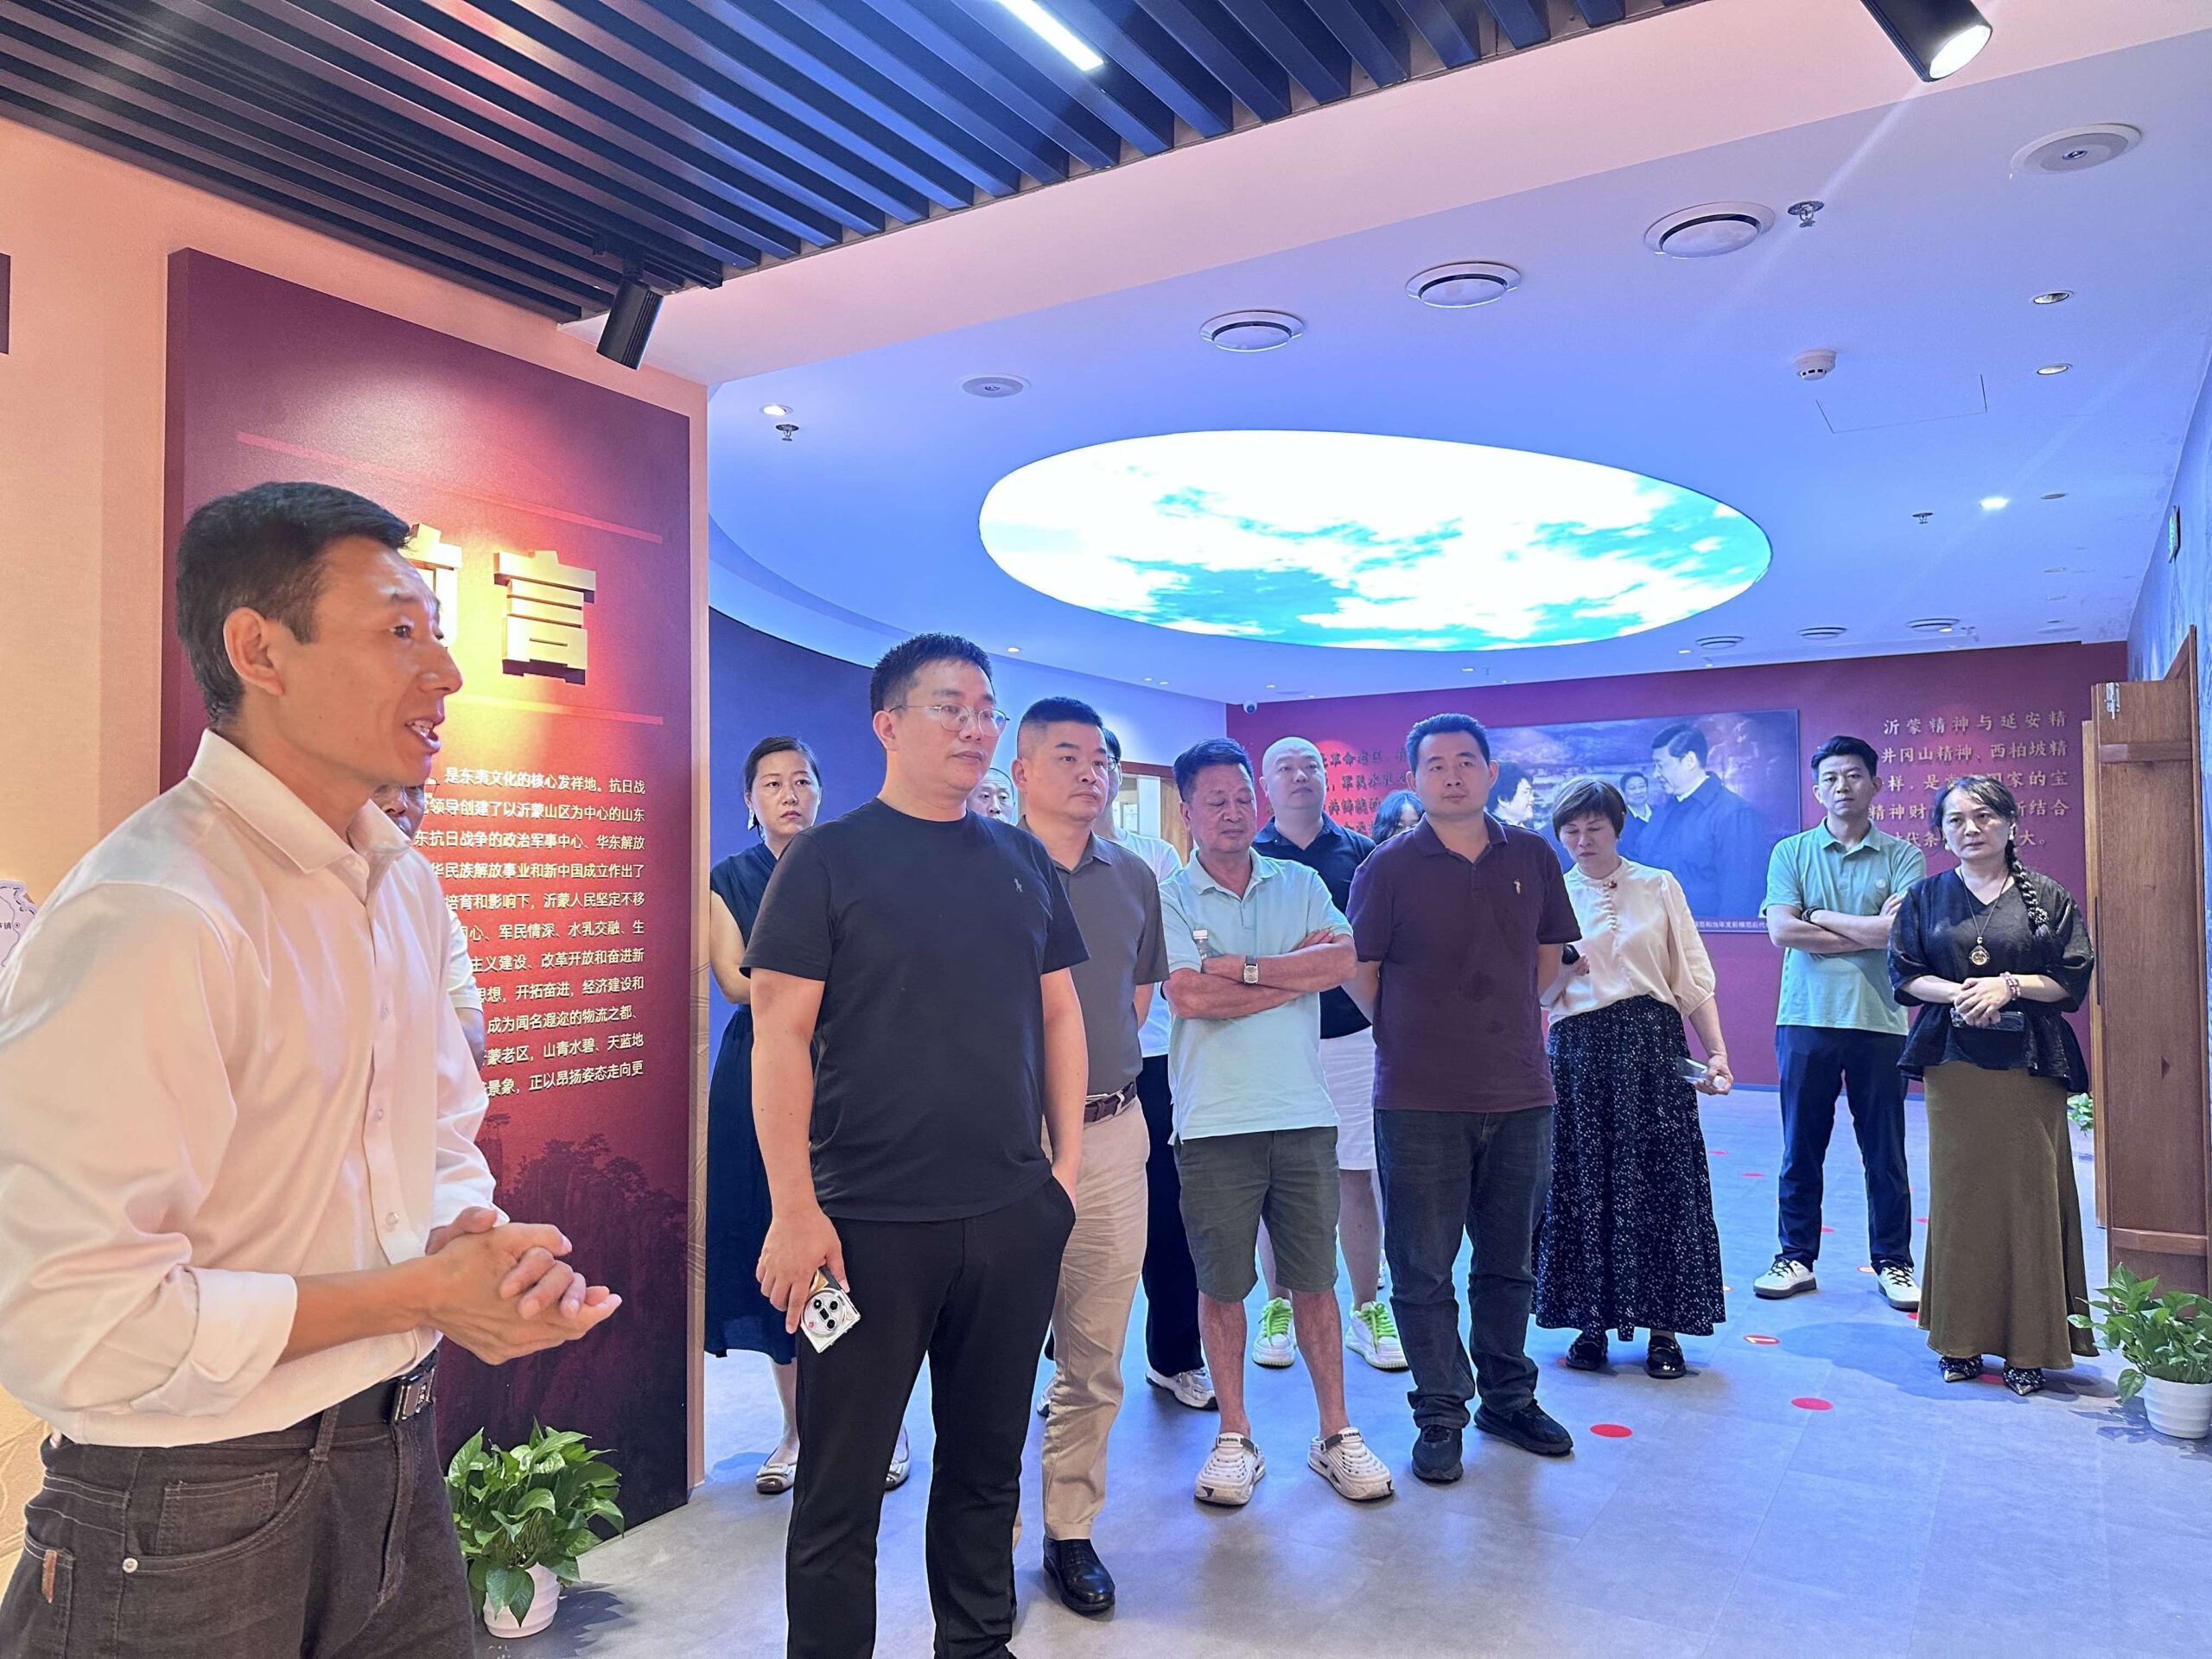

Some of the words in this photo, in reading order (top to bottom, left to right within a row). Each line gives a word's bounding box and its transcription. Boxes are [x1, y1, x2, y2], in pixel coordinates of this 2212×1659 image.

[404, 523, 596, 679] 言
[1884, 710, 2067, 735] 沂蒙精神与延安精
[1881, 740, 2068, 765] 井冈山精神、西柏坡精
[414, 830, 645, 850] 东抗日战争的政治军事中心、华东解放
[486, 1005, 638, 1034] 成为闻名遐迩的物流之都、
[483, 1032, 645, 1066] 蒙老区，山青水碧、天蓝地
[482, 1060, 644, 1096] 景象，正以昂扬姿态走向更
